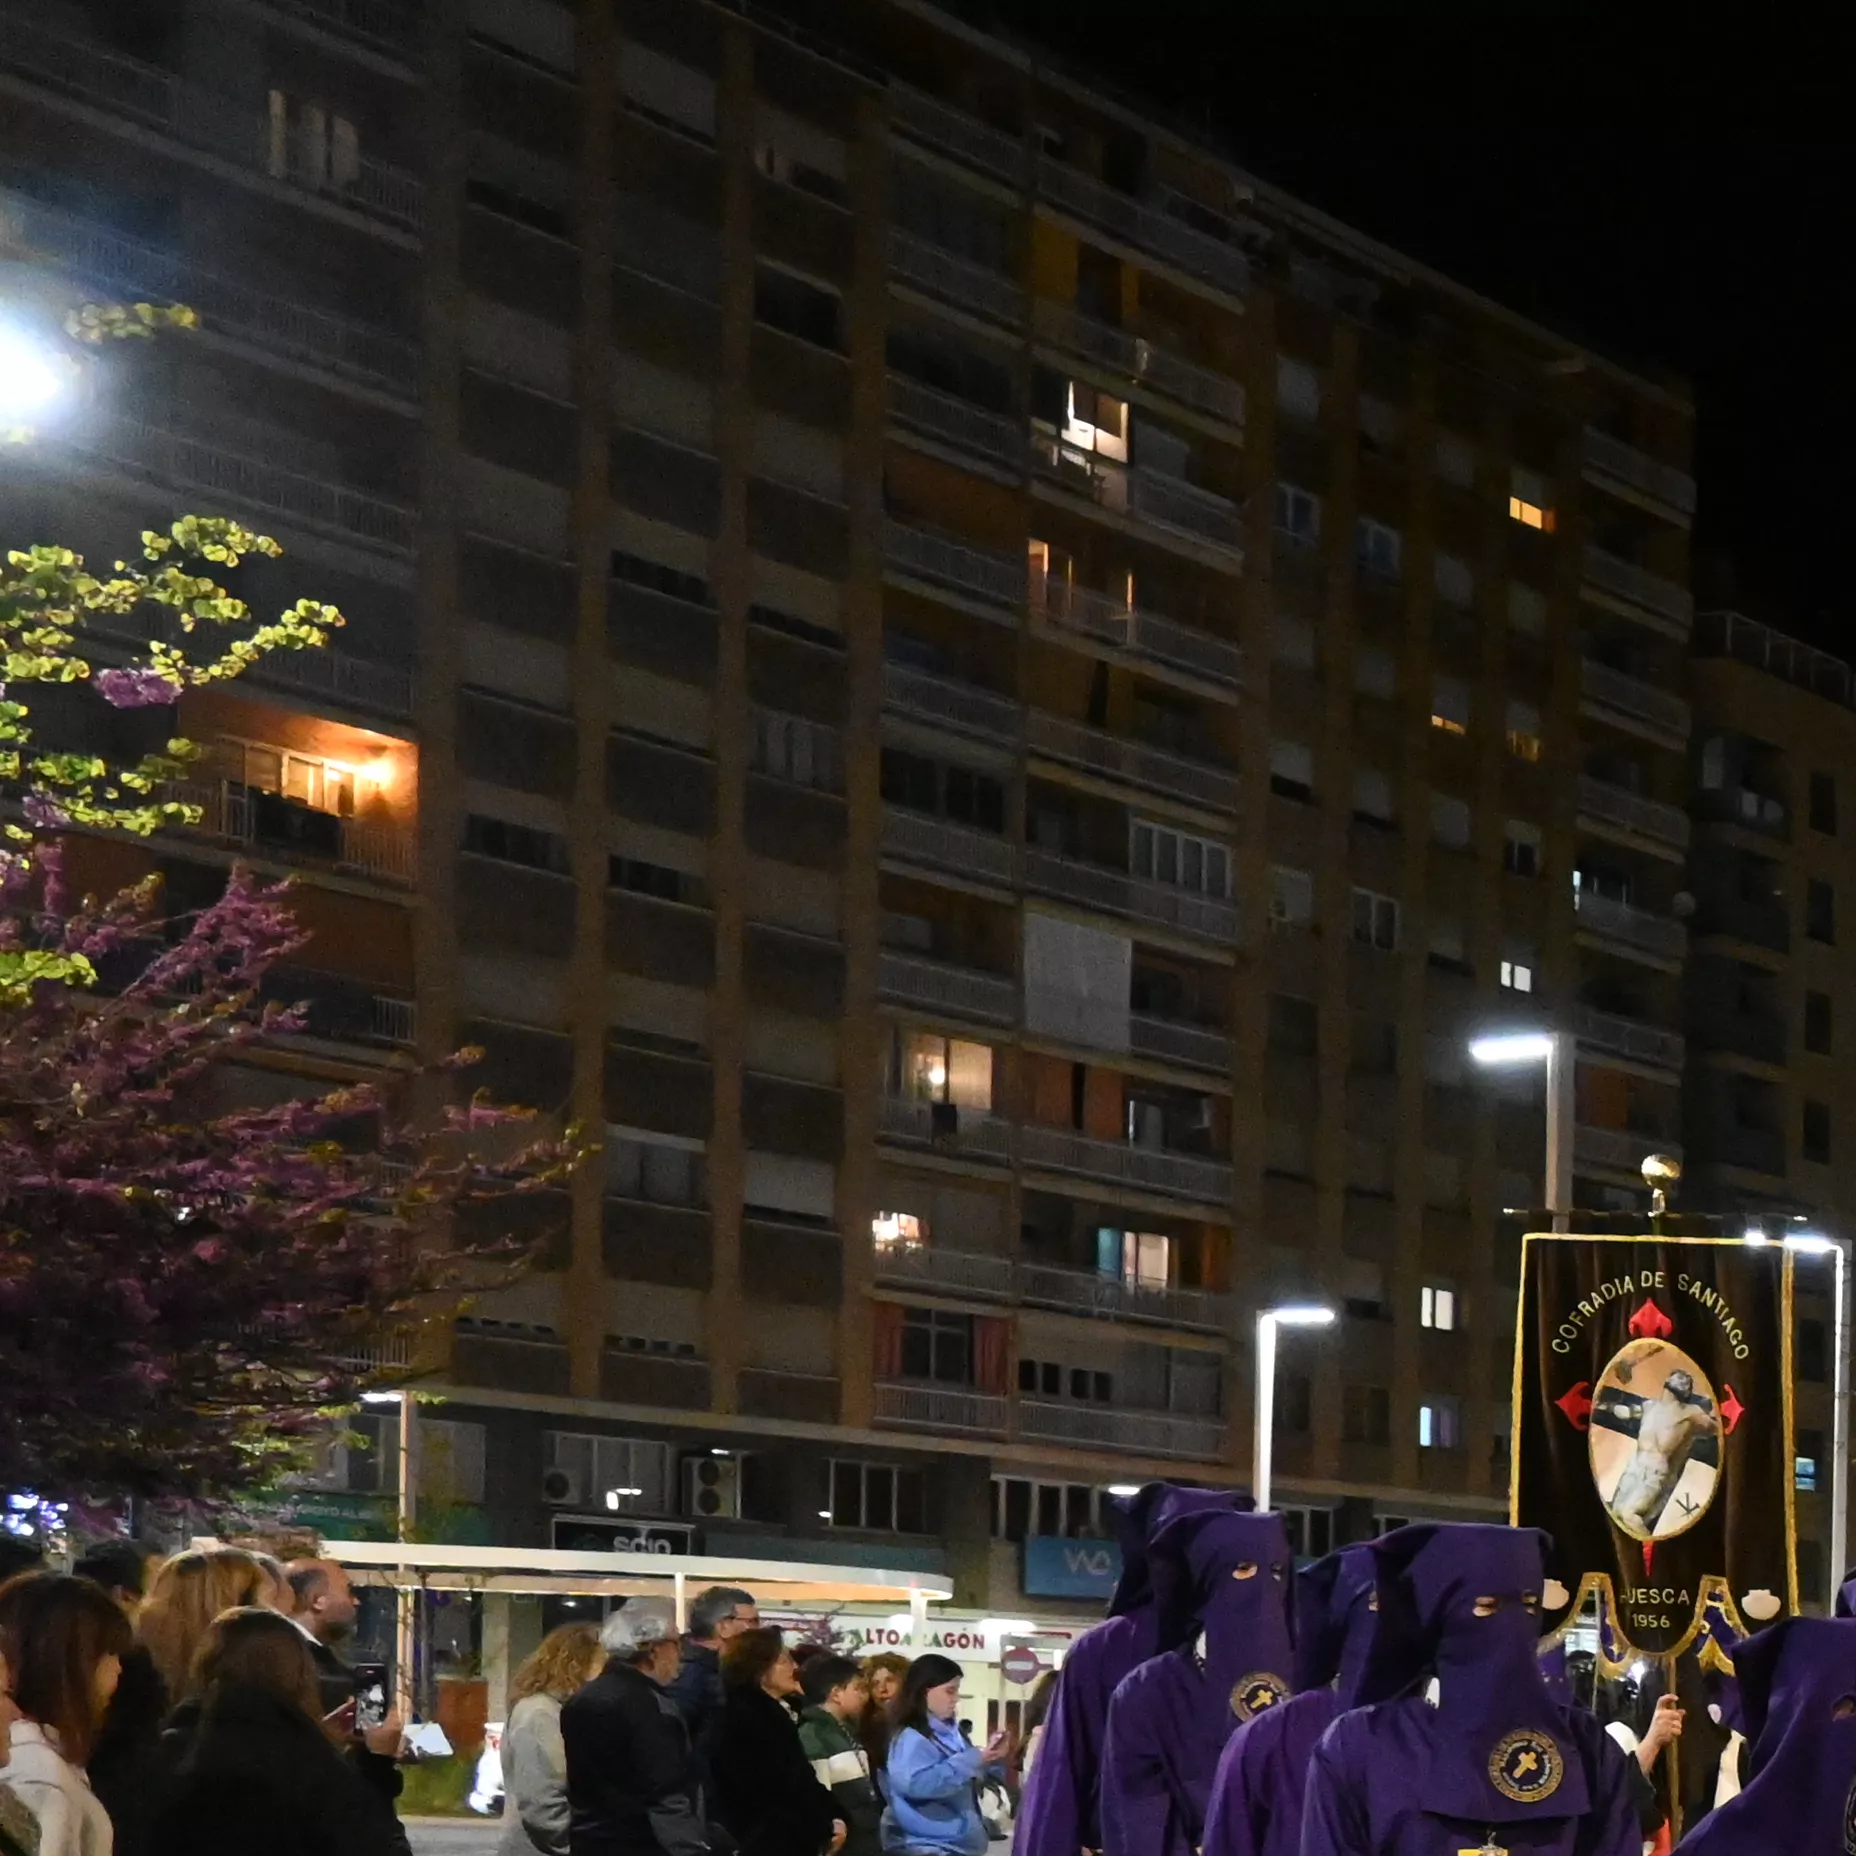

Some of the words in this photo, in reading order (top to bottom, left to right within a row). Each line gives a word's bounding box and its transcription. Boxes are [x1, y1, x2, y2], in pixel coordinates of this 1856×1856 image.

[1551, 1275, 1633, 1355] COFRADIA
[1641, 1270, 1665, 1289] DE
[1677, 1273, 1750, 1361] SANTIAGO
[1632, 1612, 1671, 1629] 1956
[849, 1627, 985, 1650] ALTOAAGÓN
